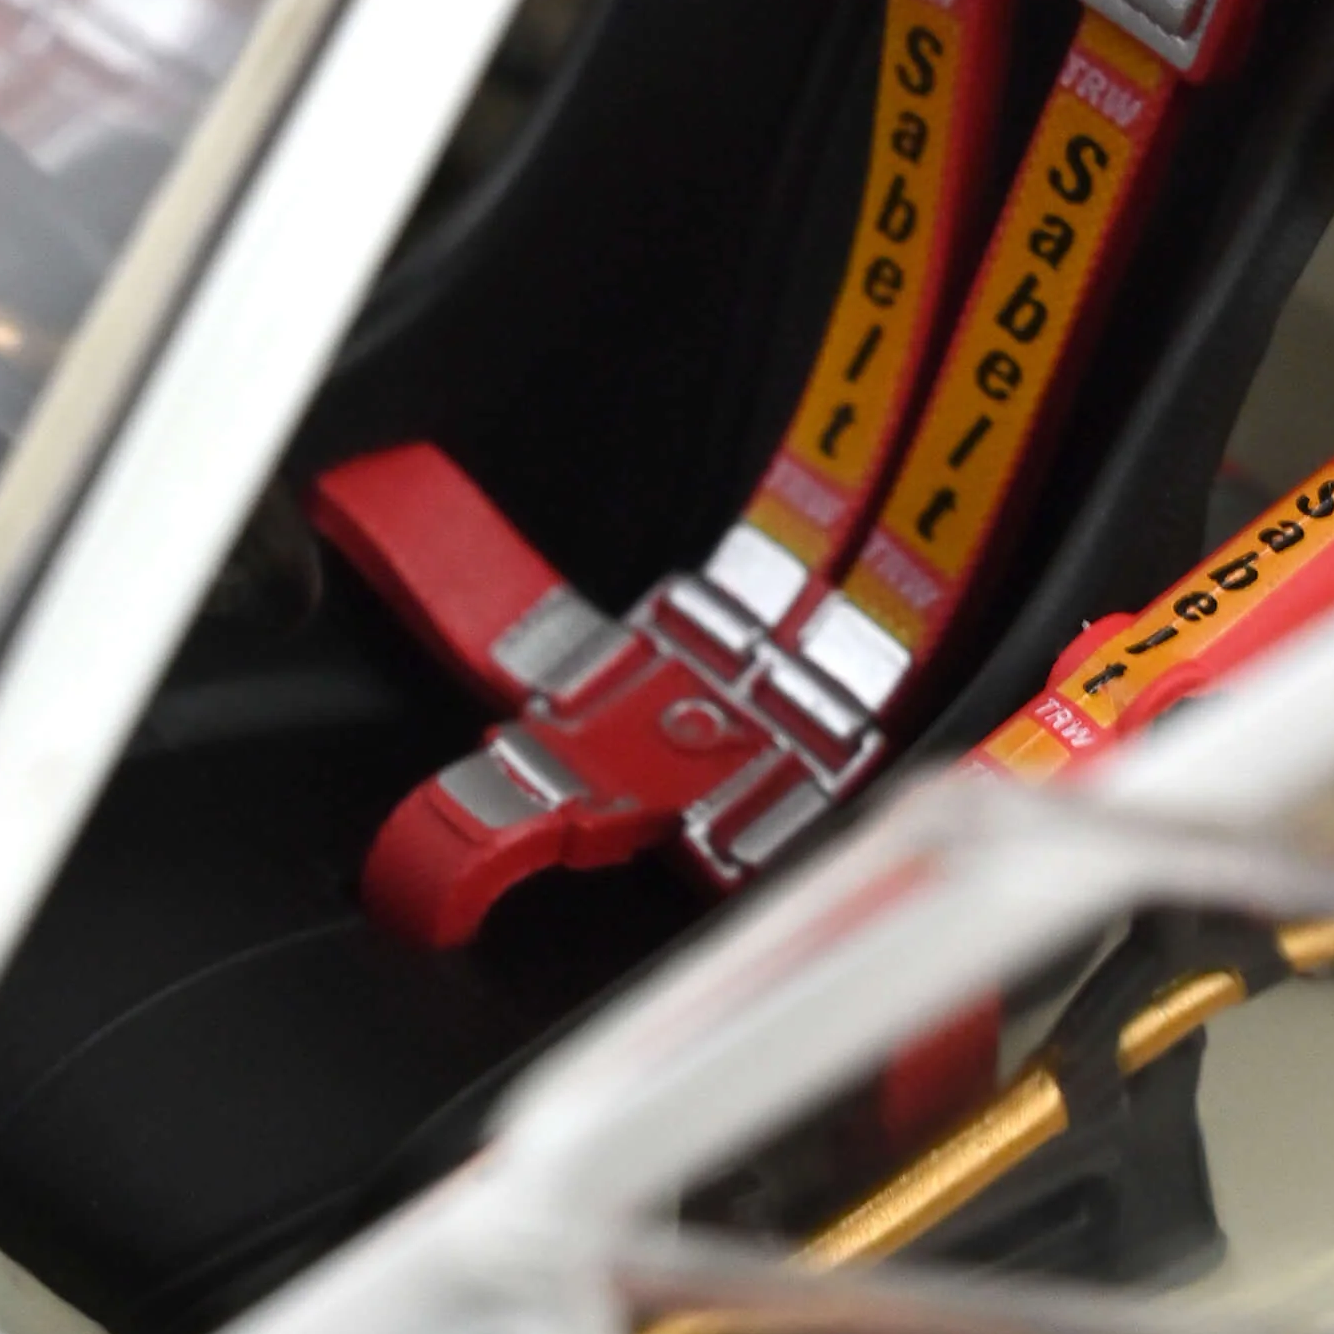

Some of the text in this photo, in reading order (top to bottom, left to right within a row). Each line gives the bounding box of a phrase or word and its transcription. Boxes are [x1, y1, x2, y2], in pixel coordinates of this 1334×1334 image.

[1061, 50, 1142, 128] TRW
[818, 25, 944, 459] Sabelt
[912, 134, 1110, 542] Sabelt
[1033, 696, 1099, 749] TRW
